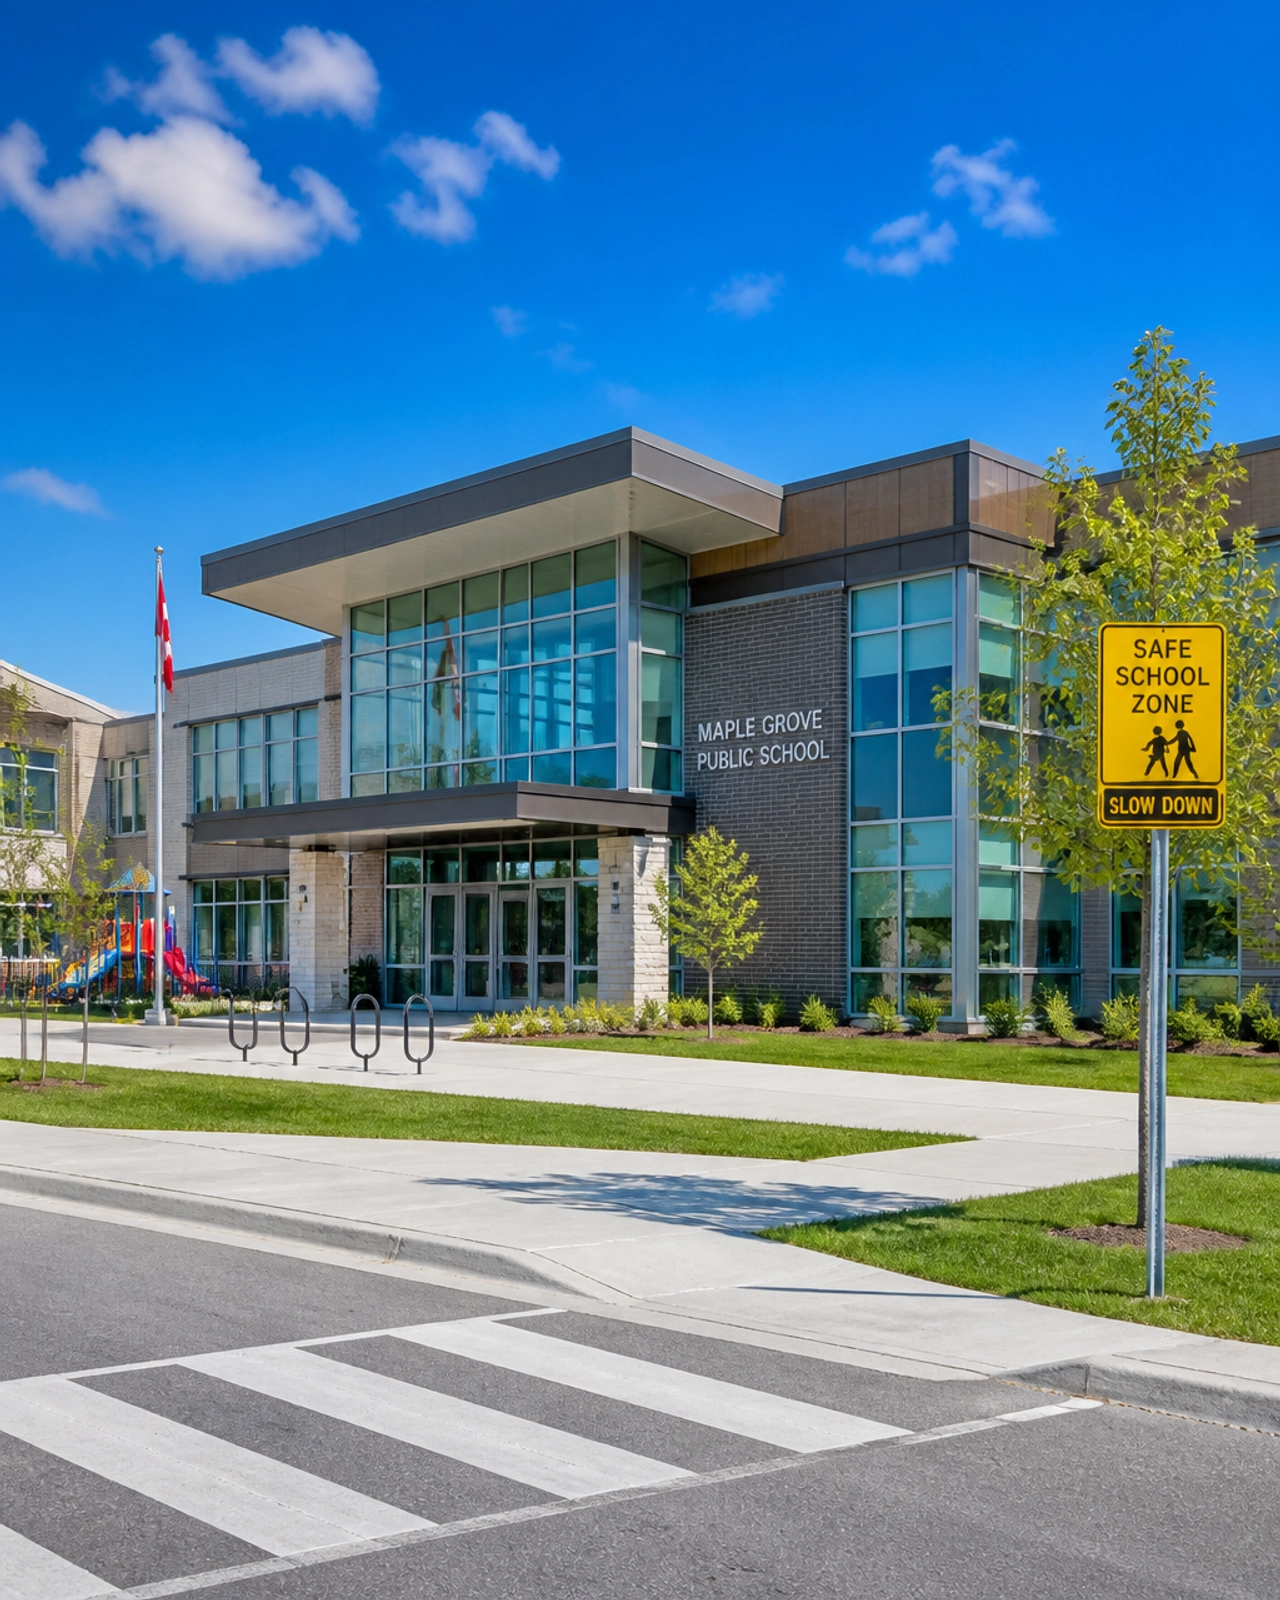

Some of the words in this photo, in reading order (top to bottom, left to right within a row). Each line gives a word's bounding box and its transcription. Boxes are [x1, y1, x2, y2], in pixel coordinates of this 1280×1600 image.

[1134, 639, 1192, 658] SAFE
[1116, 666, 1210, 686] SCHOOL
[1131, 694, 1193, 713] ZONE
[698, 717, 755, 742] MAPLE
[762, 709, 822, 734] GROVE
[697, 748, 754, 771] PUBLIC
[760, 740, 830, 765] SCHOOL
[1109, 796, 1155, 815] SLOW
[1162, 796, 1213, 815] DOWN
